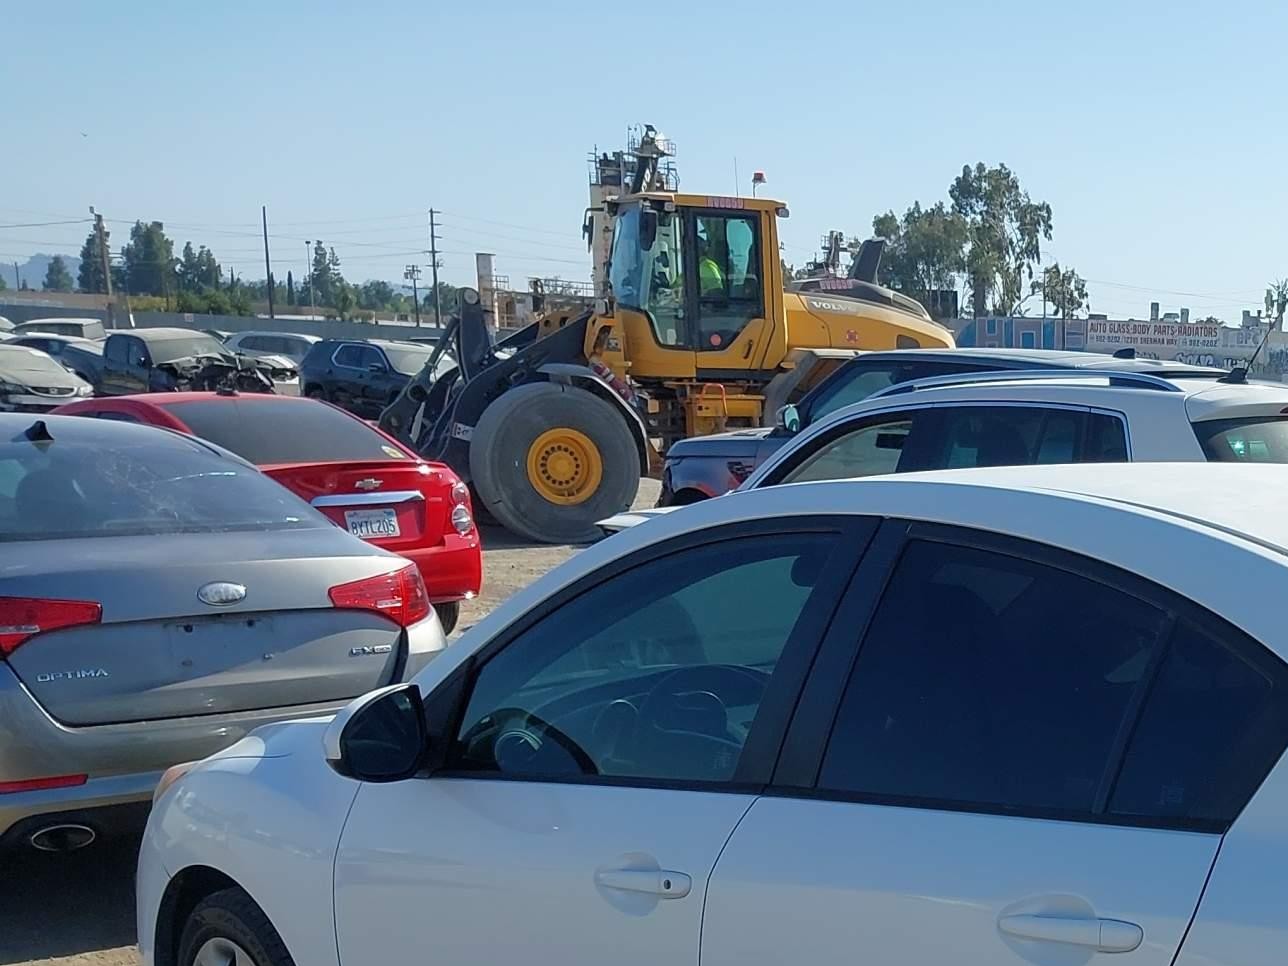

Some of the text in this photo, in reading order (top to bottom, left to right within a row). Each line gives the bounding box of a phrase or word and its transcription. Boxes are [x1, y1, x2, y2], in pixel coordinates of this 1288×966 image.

[1089, 322, 1107, 333] AUTO
[350, 519, 396, 536] 8YTL205
[37, 668, 109, 682] OPTIMA
